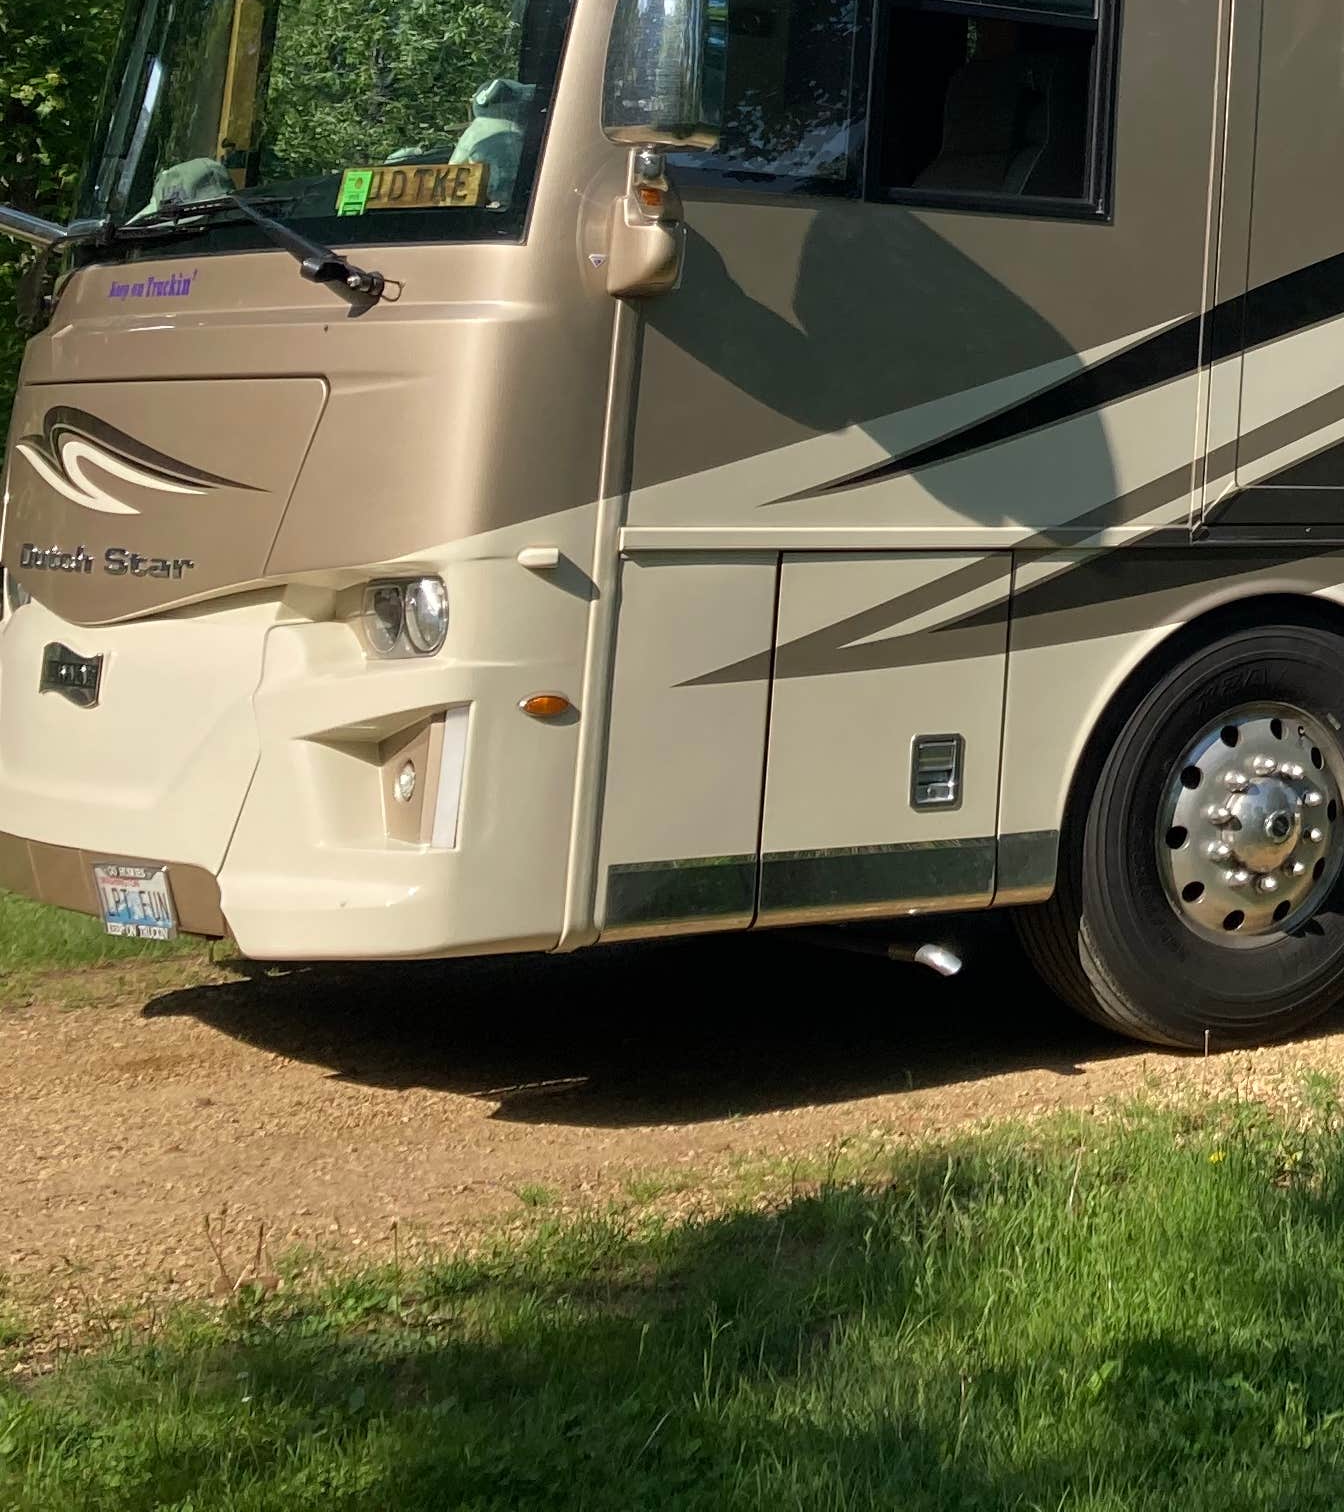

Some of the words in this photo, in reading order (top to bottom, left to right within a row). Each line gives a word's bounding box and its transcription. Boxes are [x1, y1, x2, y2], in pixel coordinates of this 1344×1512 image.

[19, 543, 94, 574] Dutch
[104, 548, 194, 579] Star
[138, 890, 170, 922] FUN
